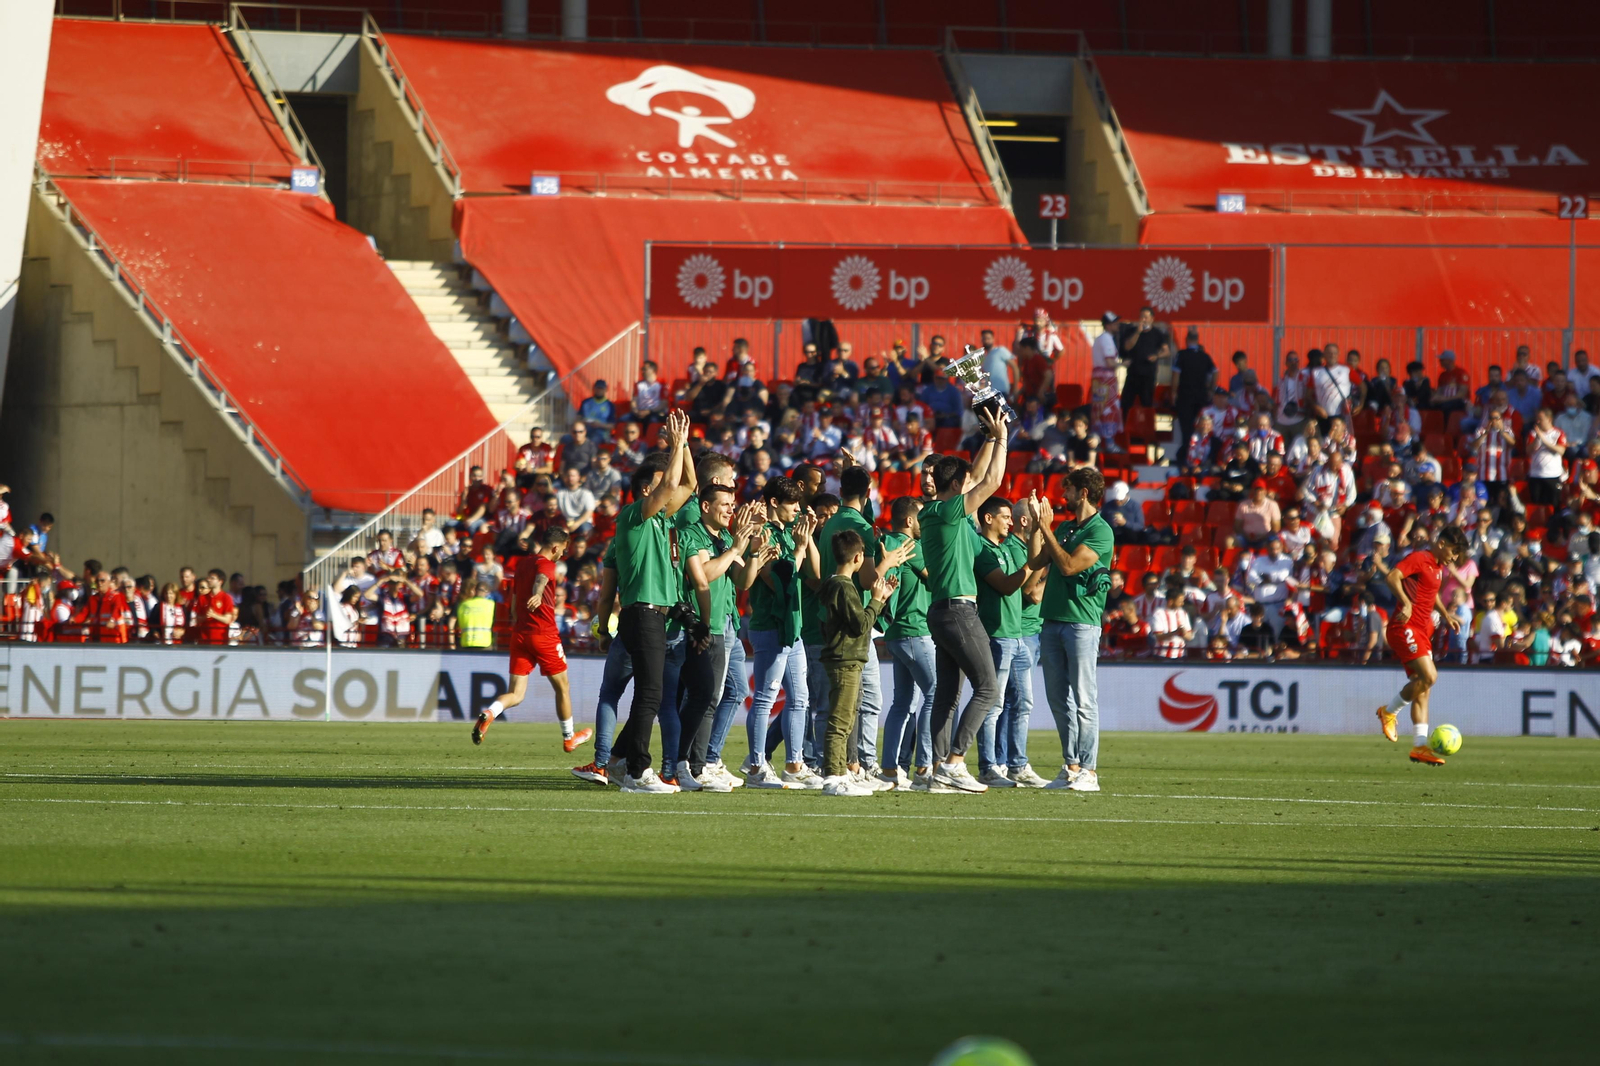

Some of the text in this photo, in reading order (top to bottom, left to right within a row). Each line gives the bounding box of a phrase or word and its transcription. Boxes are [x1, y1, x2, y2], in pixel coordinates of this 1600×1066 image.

[1221, 142, 1590, 167] ESTRELLA
[1311, 164, 1511, 179] DE LEVANTE
[1042, 194, 1067, 217] 23
[1220, 198, 1244, 212] 124
[1560, 196, 1587, 219] 22
[734, 269, 1245, 310] bp bp bp bp
[1404, 628, 1416, 645] 2
[291, 668, 508, 720] SOLAR
[1217, 680, 1299, 721] TCI
